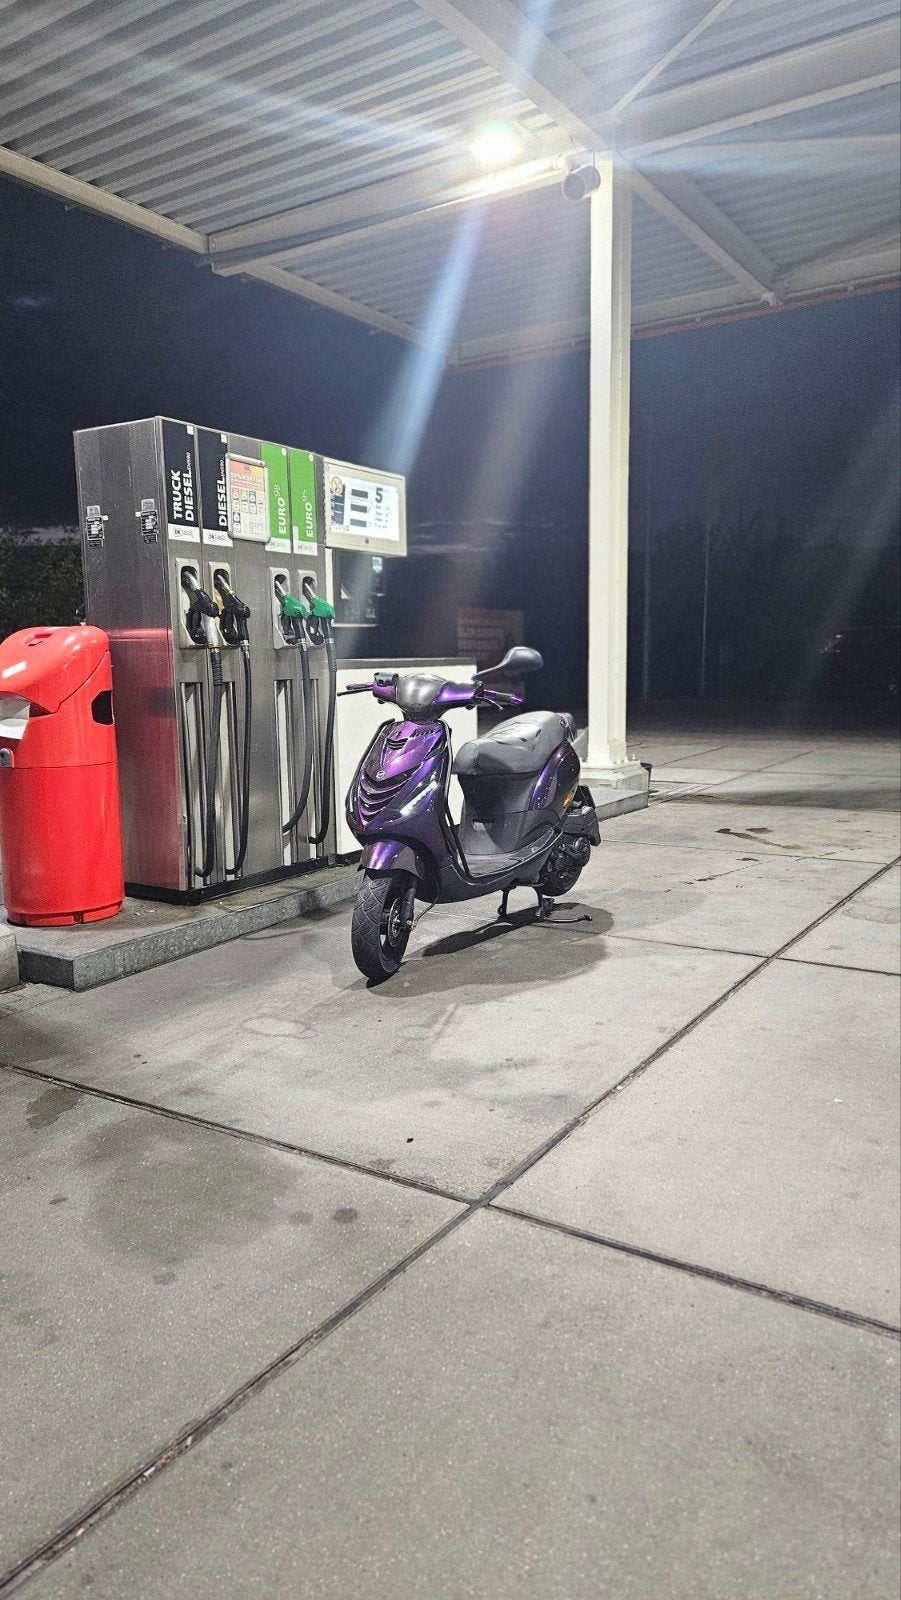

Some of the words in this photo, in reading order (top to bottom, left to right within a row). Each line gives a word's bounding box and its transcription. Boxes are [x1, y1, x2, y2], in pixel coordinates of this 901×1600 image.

[170, 469, 183, 520] TRUCK
[183, 469, 195, 522] DIESEL
[216, 475, 227, 527] DIESEL
[273, 484, 281, 497] 98
[301, 489, 308, 502] 95
[375, 486, 383, 504] 5
[277, 497, 287, 534] EURO
[304, 501, 314, 538] EURO
